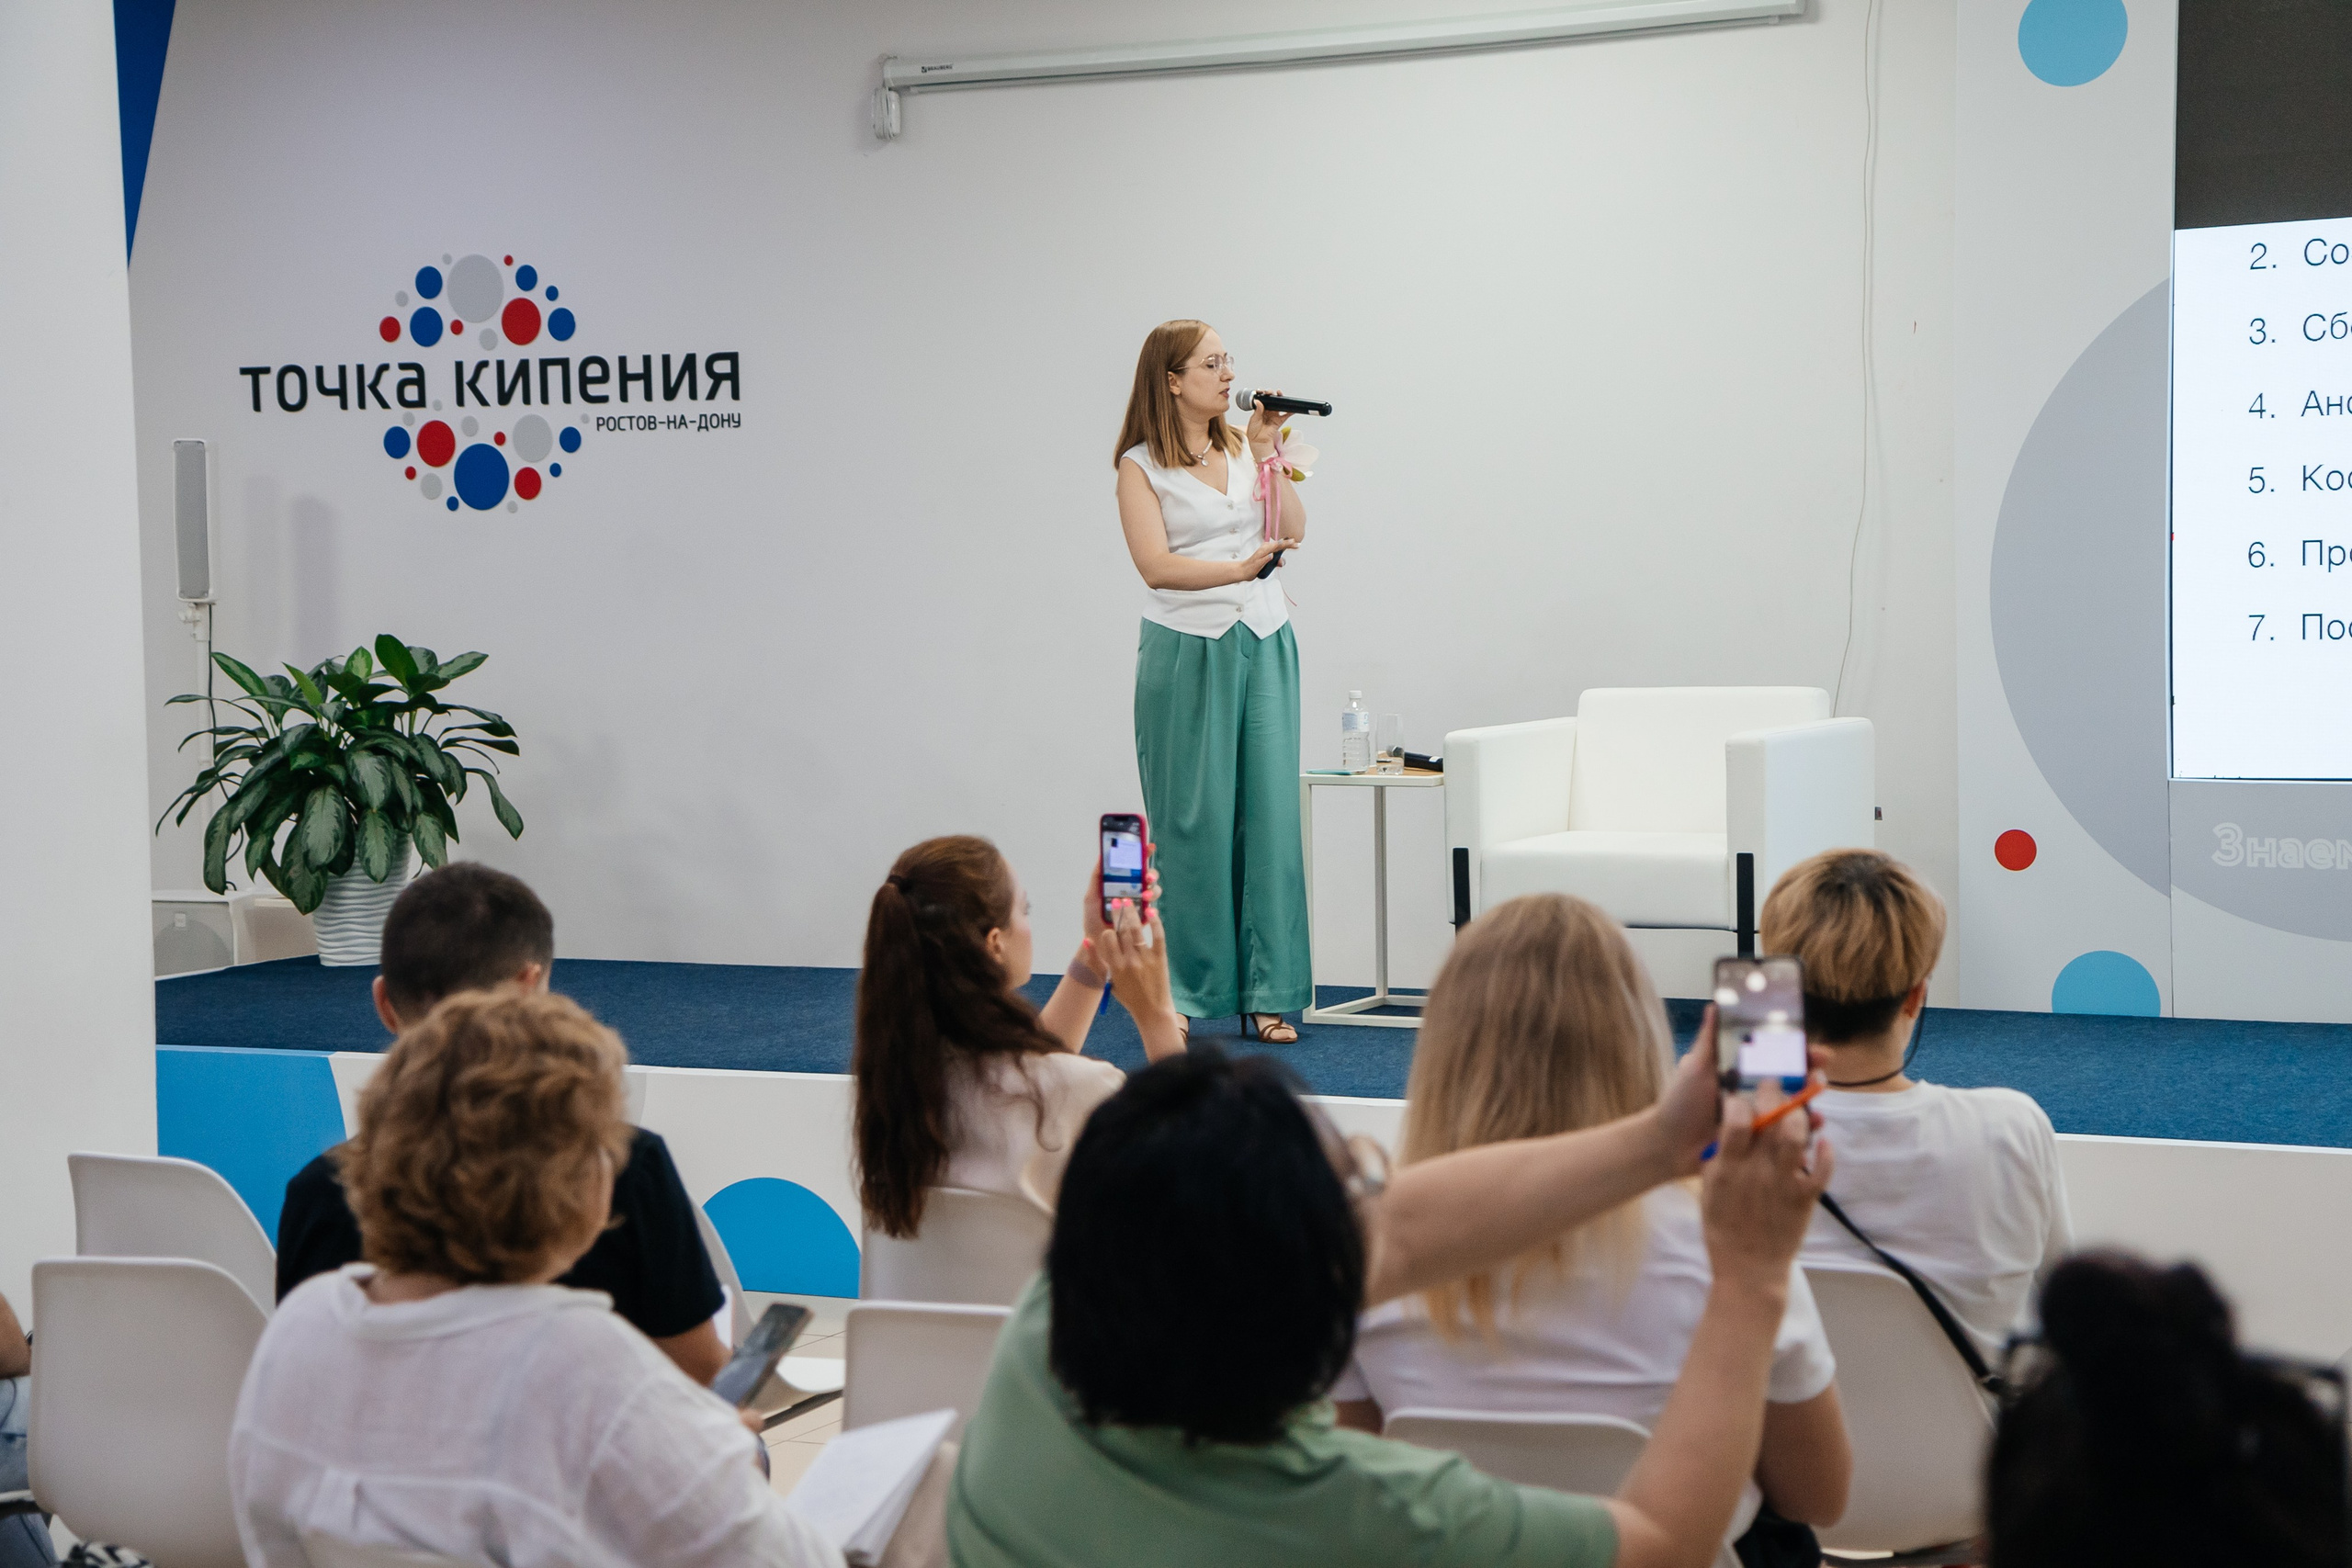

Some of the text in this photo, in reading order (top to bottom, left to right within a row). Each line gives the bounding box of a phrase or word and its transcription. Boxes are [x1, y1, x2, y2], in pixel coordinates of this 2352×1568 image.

[2250, 238, 2352, 270] 2. Со
[2249, 311, 2352, 344] 3. Сб
[2248, 390, 2352, 419] 4. Ан
[596, 412, 741, 433] РОСТОВ-НА-ДОНУ
[2248, 464, 2352, 493] 5. Ко
[2248, 539, 2352, 573] 6. Пр
[2248, 614, 2352, 641] 7. По
